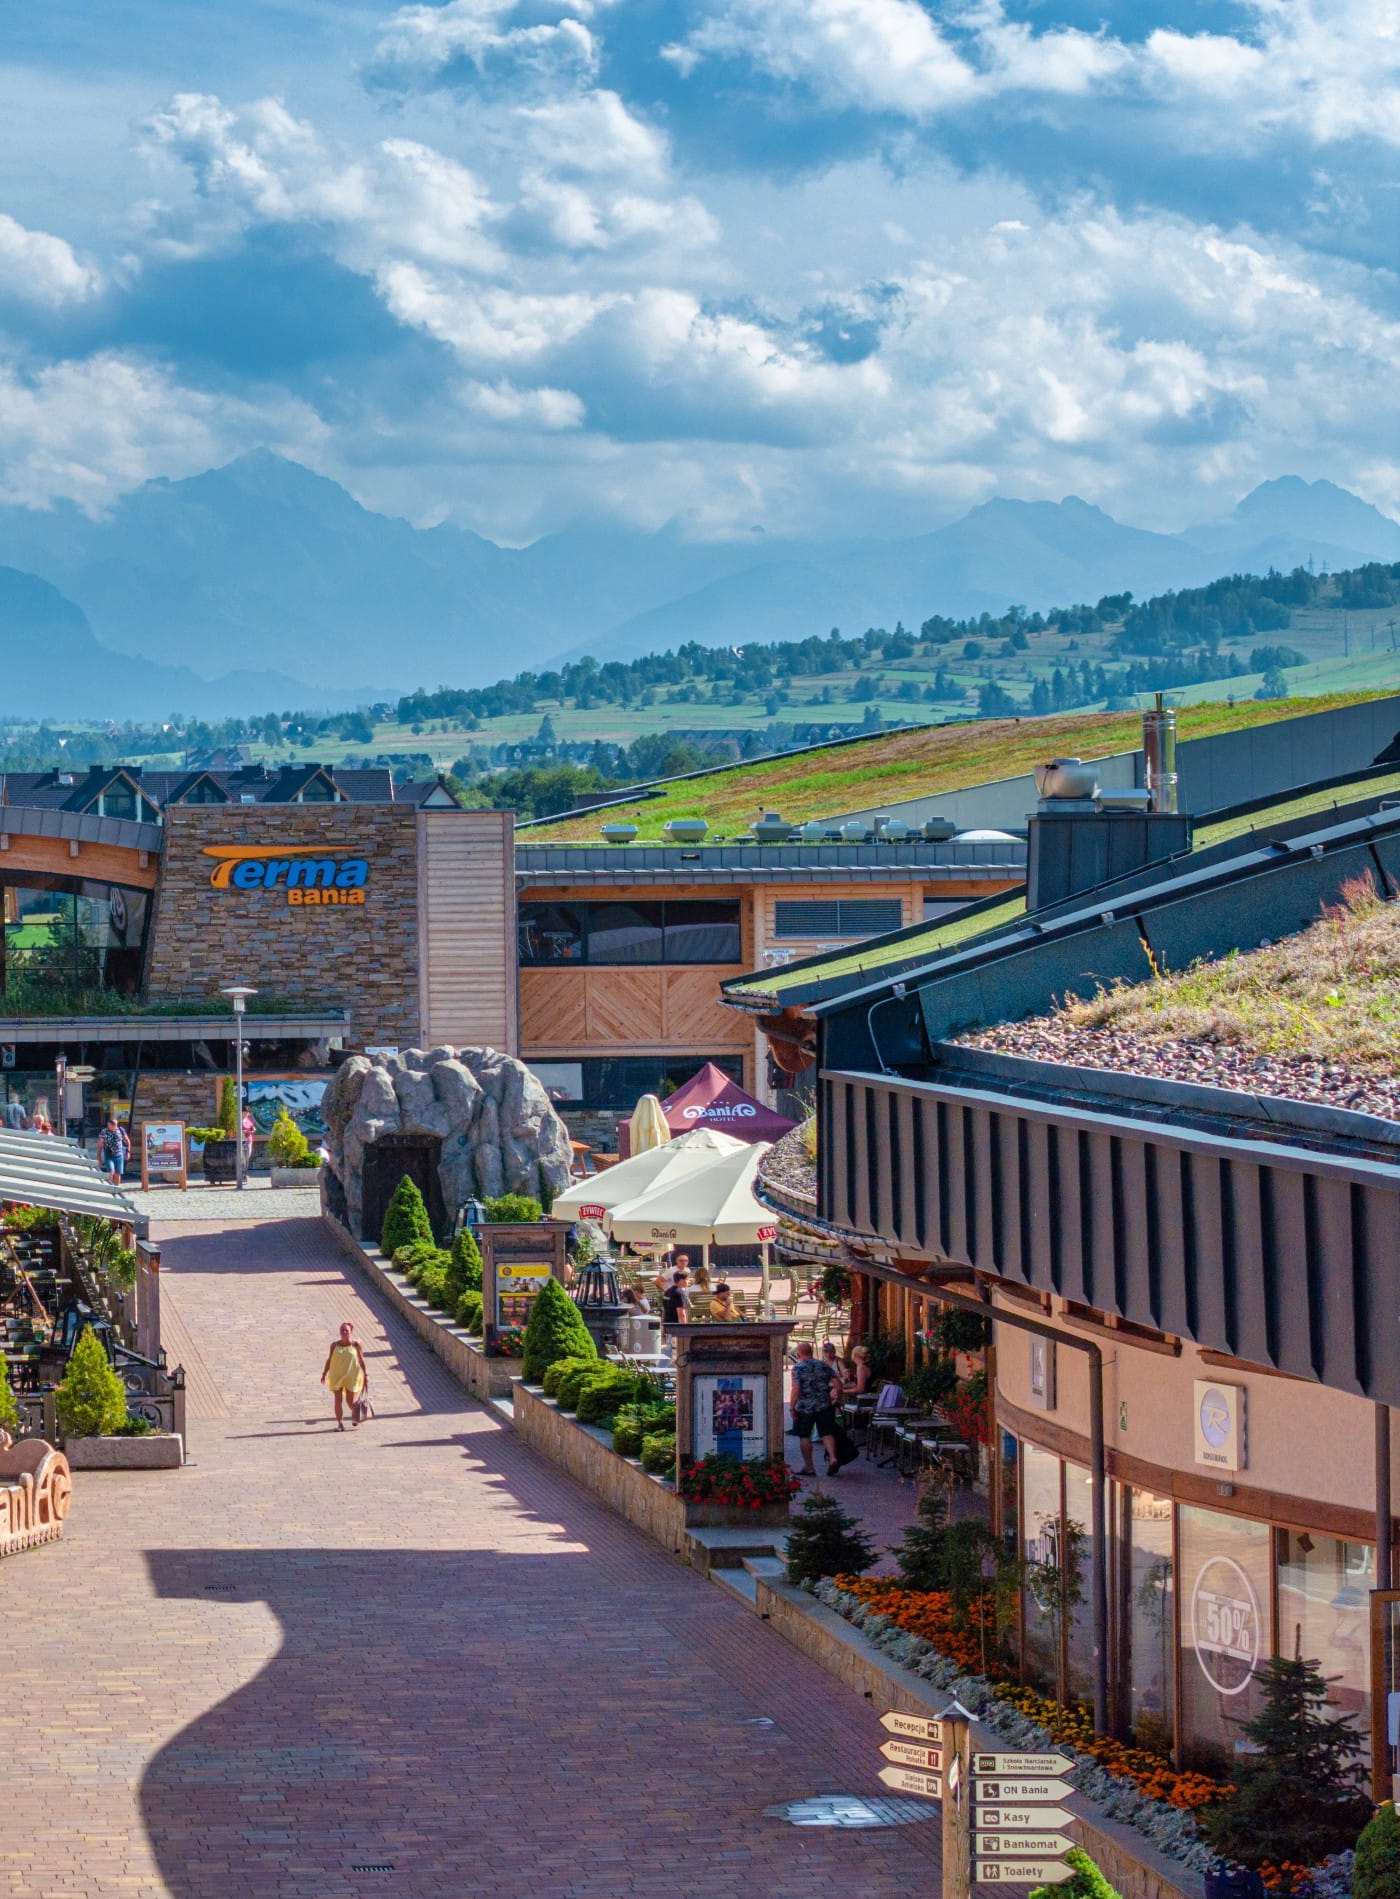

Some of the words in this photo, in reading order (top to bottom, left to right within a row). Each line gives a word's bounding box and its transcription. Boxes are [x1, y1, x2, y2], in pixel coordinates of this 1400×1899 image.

[202, 845, 369, 889] Terma
[288, 889, 365, 905] Bania
[1207, 1601, 1250, 1652] 50%
[894, 1718, 926, 1735] Recepcja
[889, 1743, 926, 1757] Restauracja
[1003, 1786, 1018, 1794] ON
[1021, 1785, 1049, 1795] Bania
[1003, 1812, 1031, 1824] Kasy
[1003, 1839, 1058, 1849] Bankomat
[1003, 1866, 1043, 1878] Toalety
